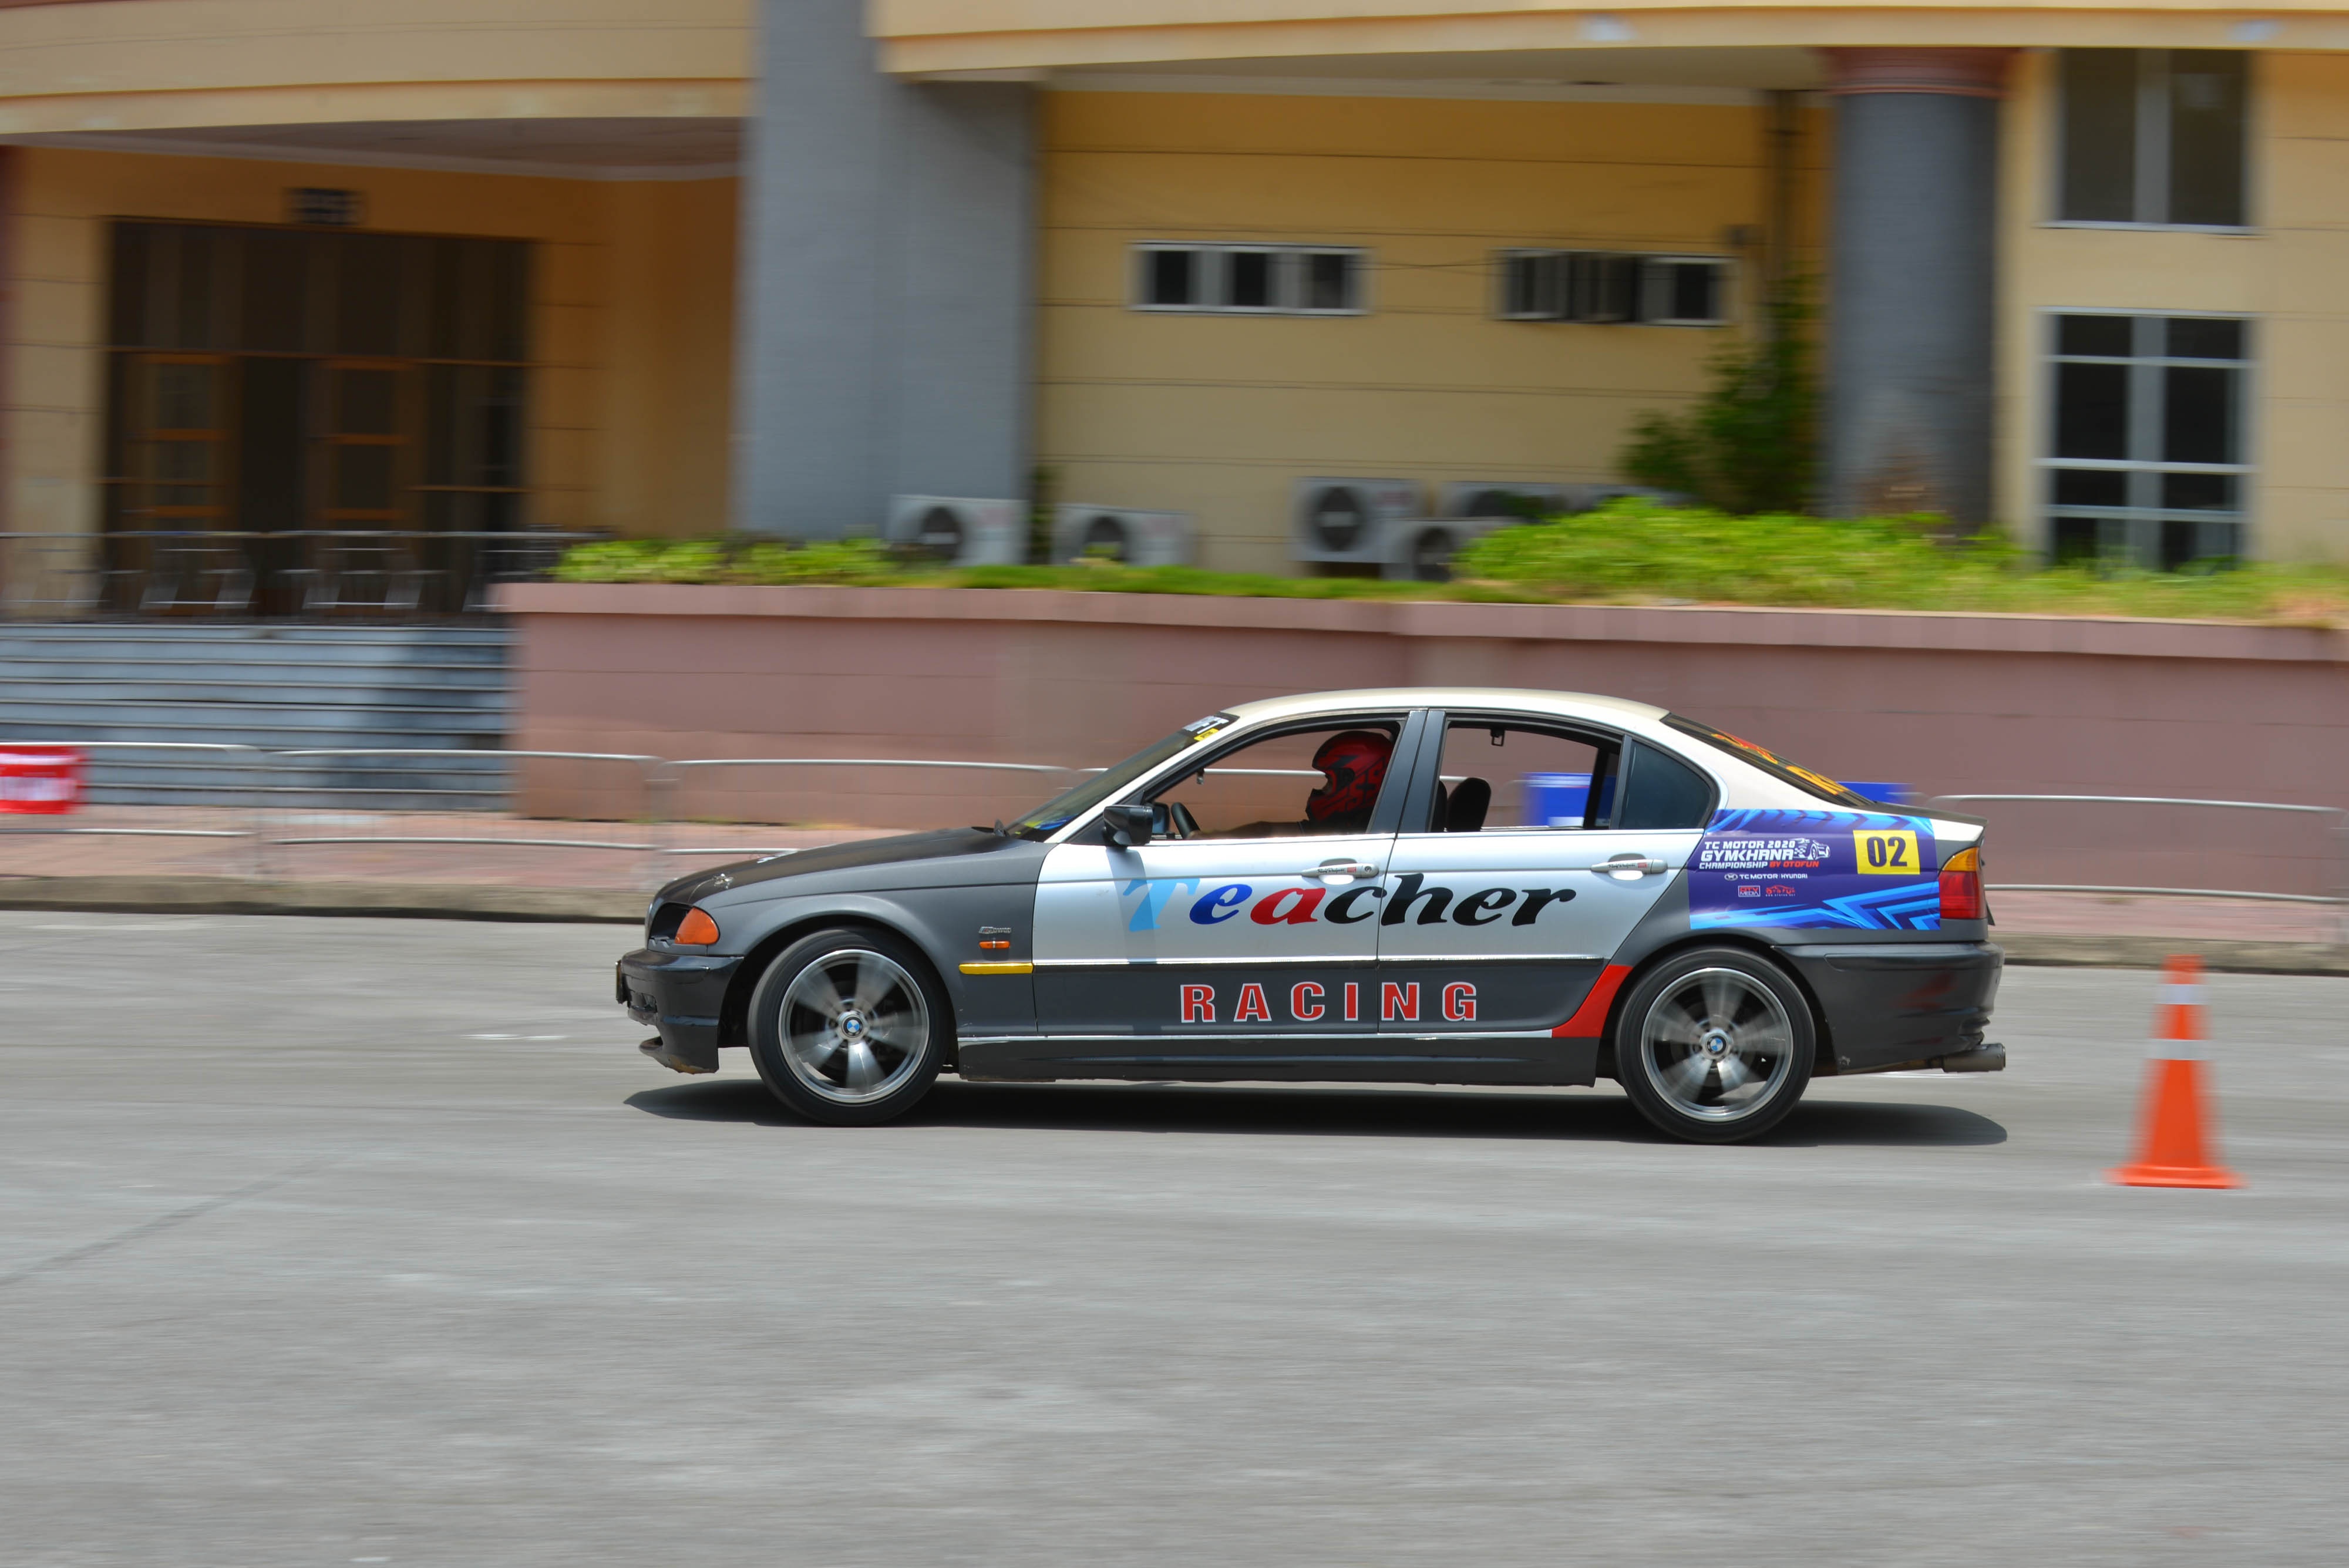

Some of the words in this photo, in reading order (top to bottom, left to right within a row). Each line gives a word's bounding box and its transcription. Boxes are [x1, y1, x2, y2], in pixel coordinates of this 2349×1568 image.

[1701, 849, 1794, 862] GYMKHANA
[1704, 841, 1720, 850] TC
[1722, 840, 1765, 849] MOTOR
[1767, 840, 1796, 849] 2020
[1866, 836, 1908, 868] 02
[1699, 861, 1768, 869] CHAMPIONSHIP
[1122, 873, 1577, 933] Teacher
[1180, 981, 1477, 1024] RACING
